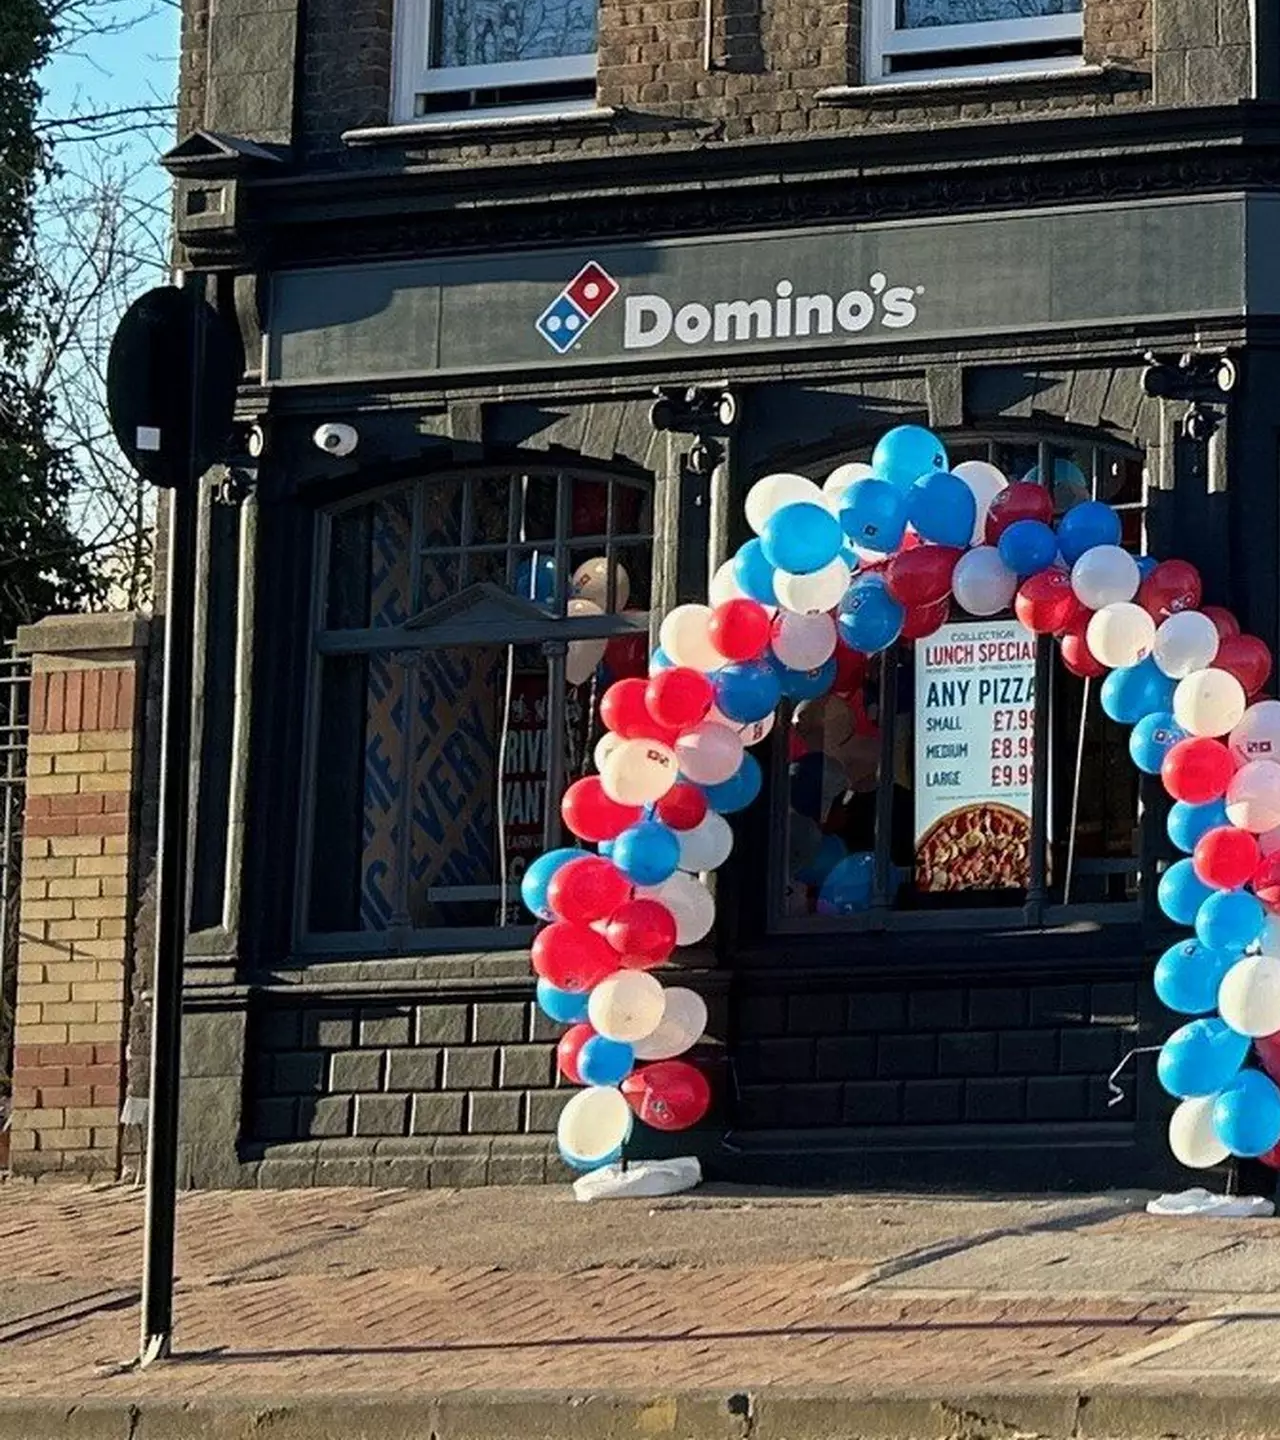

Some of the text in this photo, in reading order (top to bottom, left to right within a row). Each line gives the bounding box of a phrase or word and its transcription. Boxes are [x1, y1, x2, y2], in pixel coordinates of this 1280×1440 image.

[623, 272, 918, 349] Domino's
[951, 630, 1016, 641] COLLECTION
[926, 643, 974, 666] LUNCH
[926, 677, 1036, 707] ANY PIZZA
[926, 716, 962, 731] SMALL
[926, 742, 968, 758] MEDIUM
[926, 771, 962, 787] LARGE
